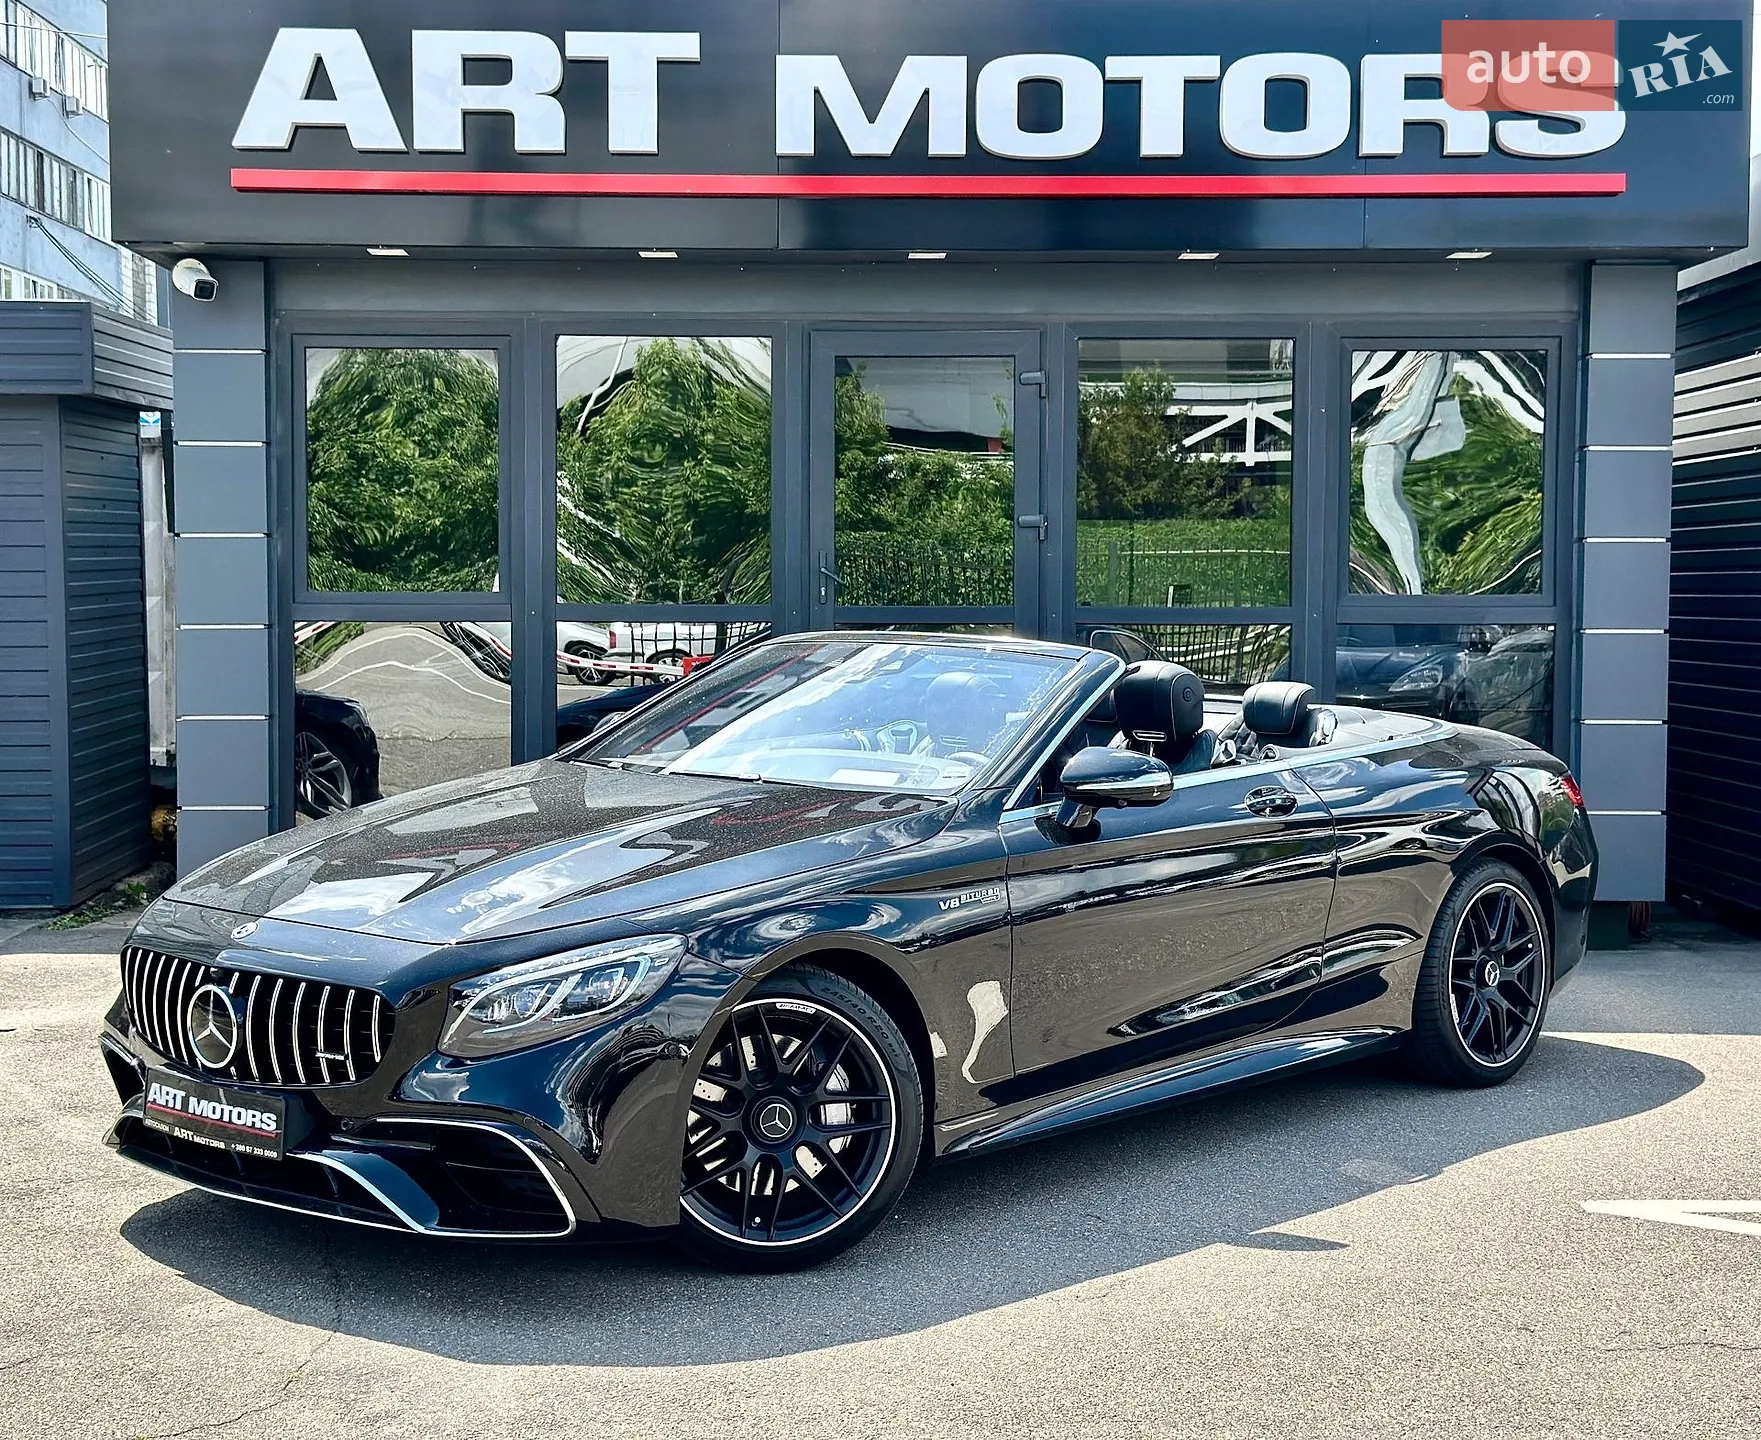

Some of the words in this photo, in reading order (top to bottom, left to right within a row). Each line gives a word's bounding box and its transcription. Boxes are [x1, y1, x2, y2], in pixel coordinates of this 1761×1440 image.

[231, 27, 700, 153] ART
[774, 53, 1626, 159] MOTORS
[939, 898, 960, 911] V8
[867, 1016, 889, 1039] R20
[148, 1083, 186, 1110] ART
[189, 1096, 277, 1131] MOTORS
[174, 1127, 194, 1141] ART
[194, 1135, 225, 1149] MOTORS
